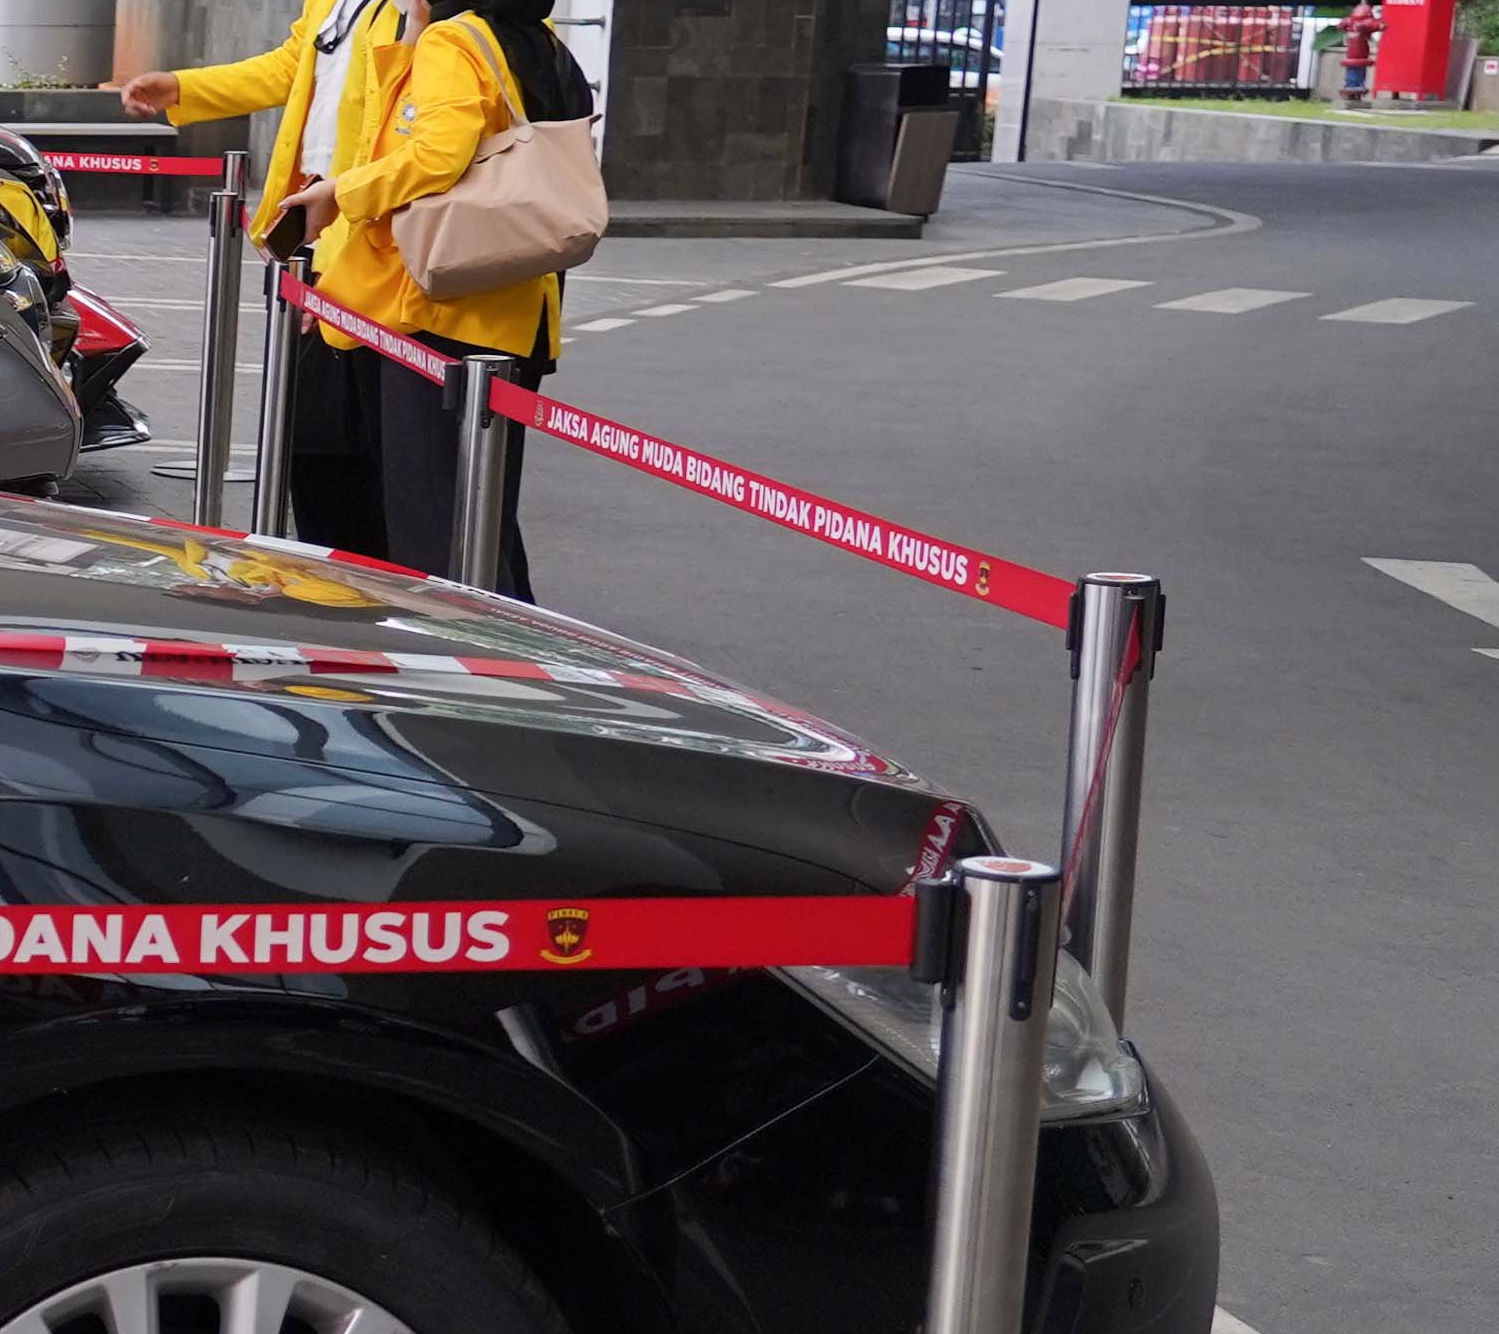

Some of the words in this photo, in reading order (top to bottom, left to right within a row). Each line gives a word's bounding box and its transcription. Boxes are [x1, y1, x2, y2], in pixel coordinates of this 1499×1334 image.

[79, 156, 143, 171] KHUSUS
[547, 406, 588, 442] JAKSA
[590, 422, 639, 460] AGUNG
[641, 439, 683, 478] MUDA
[685, 456, 745, 502] BIDANG
[749, 480, 812, 529] TINDAK
[813, 506, 883, 556] PIDANA
[887, 531, 969, 585] KHUSUS
[200, 910, 510, 964] KHUSUS
